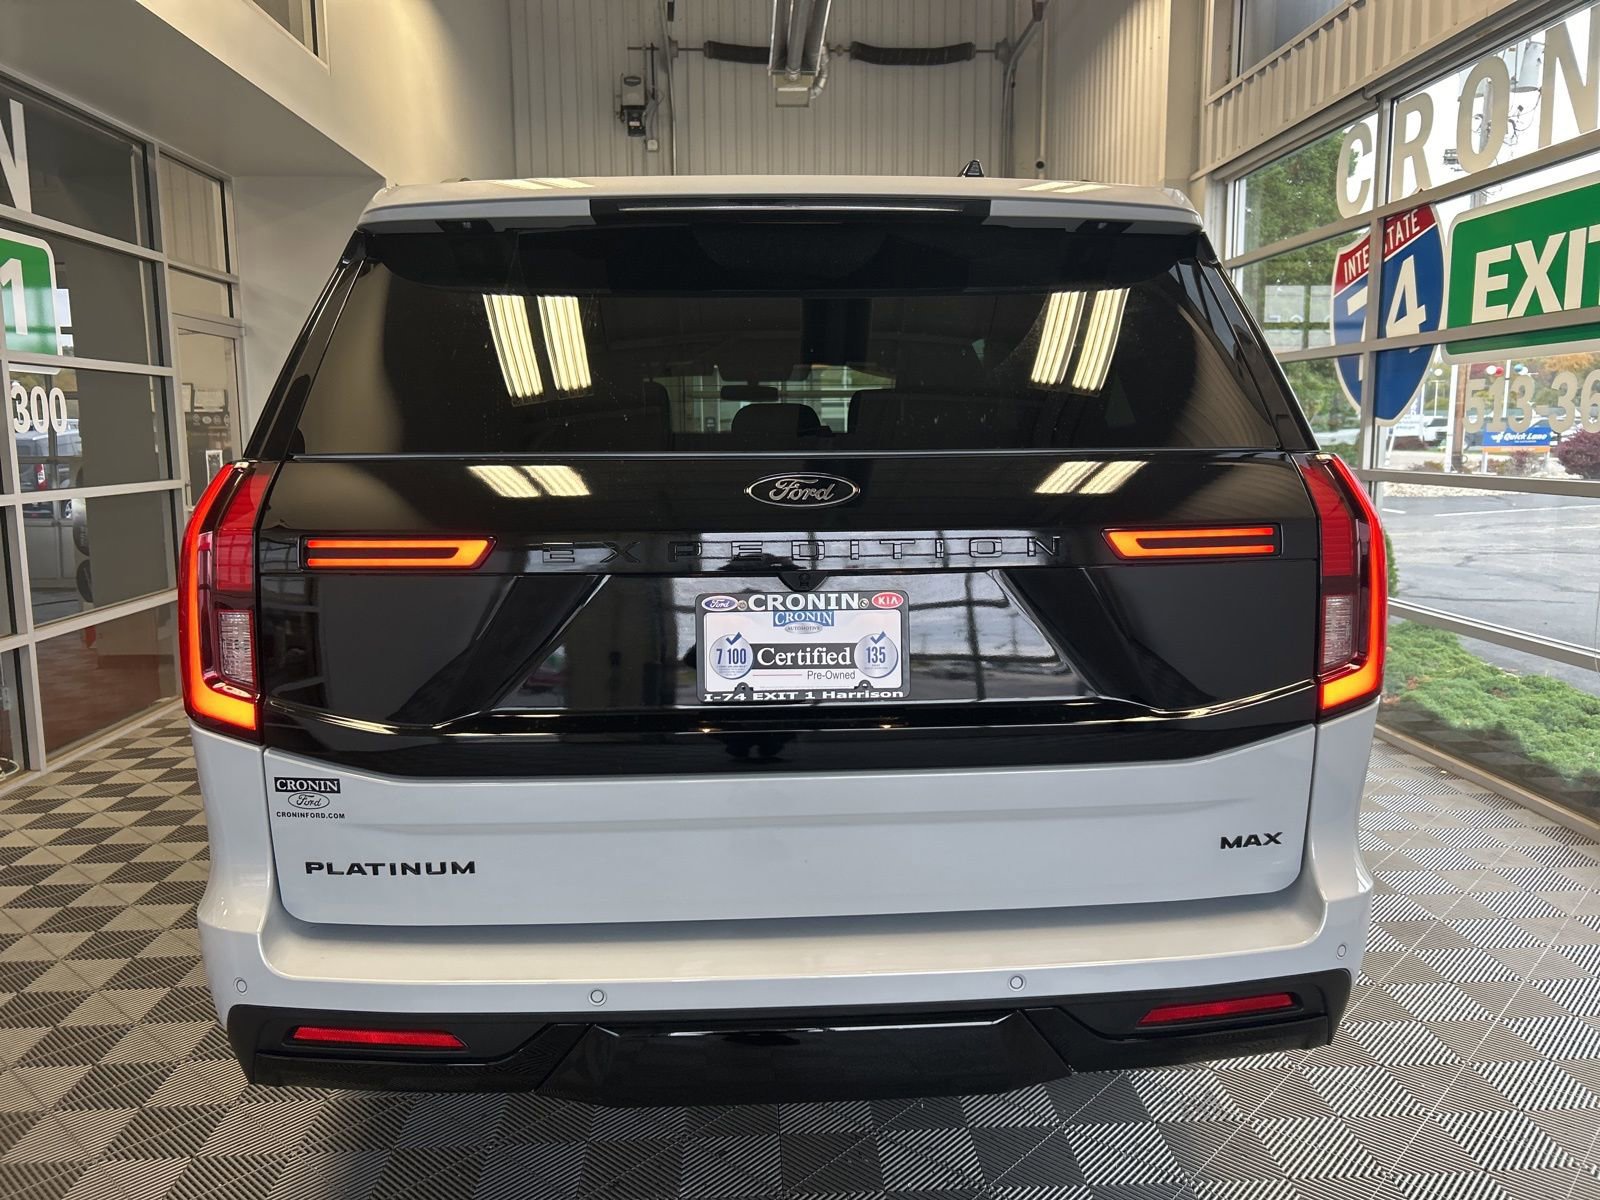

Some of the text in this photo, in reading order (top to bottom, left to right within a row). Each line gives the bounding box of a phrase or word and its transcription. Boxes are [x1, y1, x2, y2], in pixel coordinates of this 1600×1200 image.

[1343, 208, 1420, 284] INTETATE
[1471, 223, 1600, 324] EXI
[0, 257, 28, 336] 1
[11, 385, 67, 435] 300
[1503, 432, 1525, 441] Quick
[769, 478, 835, 501] Ford
[542, 534, 1061, 564] EXPEDITION
[748, 593, 859, 611] CRONIN
[877, 596, 899, 605] KIA
[774, 611, 833, 626] CRONIN
[727, 648, 747, 665] 100
[757, 647, 851, 666] Certified
[866, 646, 886, 664] 135
[807, 670, 856, 680] Pre-Owned
[704, 689, 904, 702] I-74 EXIT 1 Harrison
[276, 779, 338, 792] CRONIN
[296, 794, 322, 807] Ford
[276, 811, 346, 819] CRONINFORD.COM
[1220, 831, 1283, 849] MAX
[305, 860, 475, 876] PLATINUM
